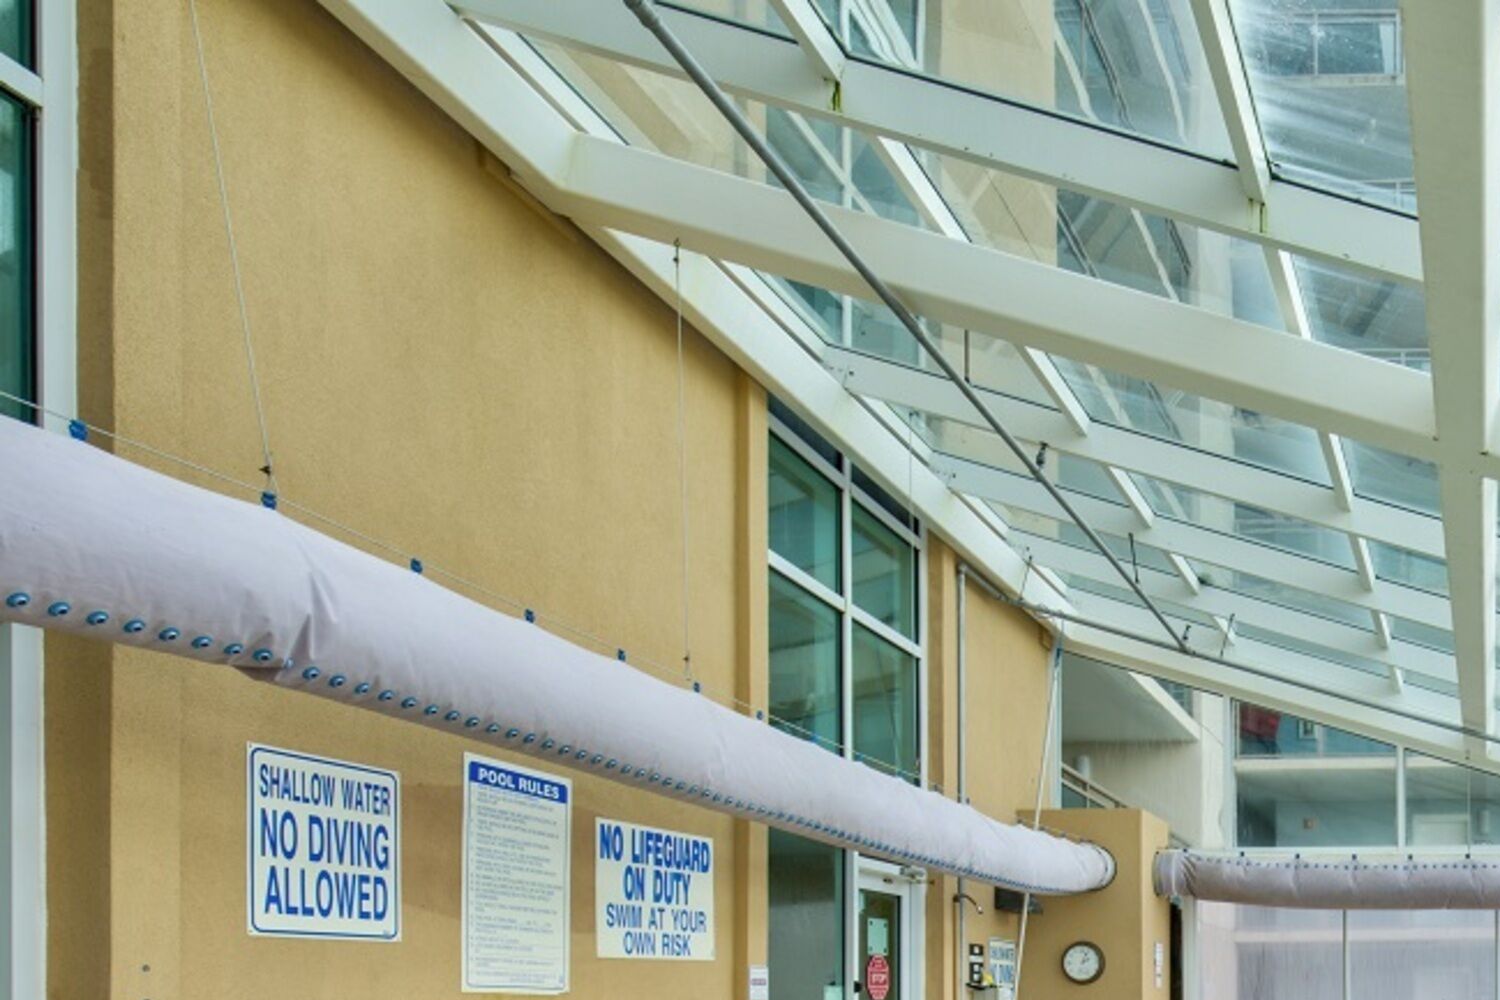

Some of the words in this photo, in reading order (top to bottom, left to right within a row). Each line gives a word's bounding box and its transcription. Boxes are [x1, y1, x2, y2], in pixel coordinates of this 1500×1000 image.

[259, 763, 335, 806] SHALLOW
[341, 783, 390, 816] WATER
[477, 767, 516, 789] POOL
[518, 777, 560, 799] RULES
[261, 808, 297, 853] NO
[308, 816, 390, 870] DIVING
[600, 825, 623, 861] NO
[631, 829, 711, 873] LIFEGUARD
[264, 866, 389, 921] ALLOWED
[624, 872, 647, 901] ON
[653, 873, 691, 906] DUTY
[606, 906, 642, 929] SWIM
[648, 909, 668, 930] AT
[671, 910, 707, 933] YOUR
[624, 936, 656, 956] OWN
[662, 935, 691, 957] RISK
